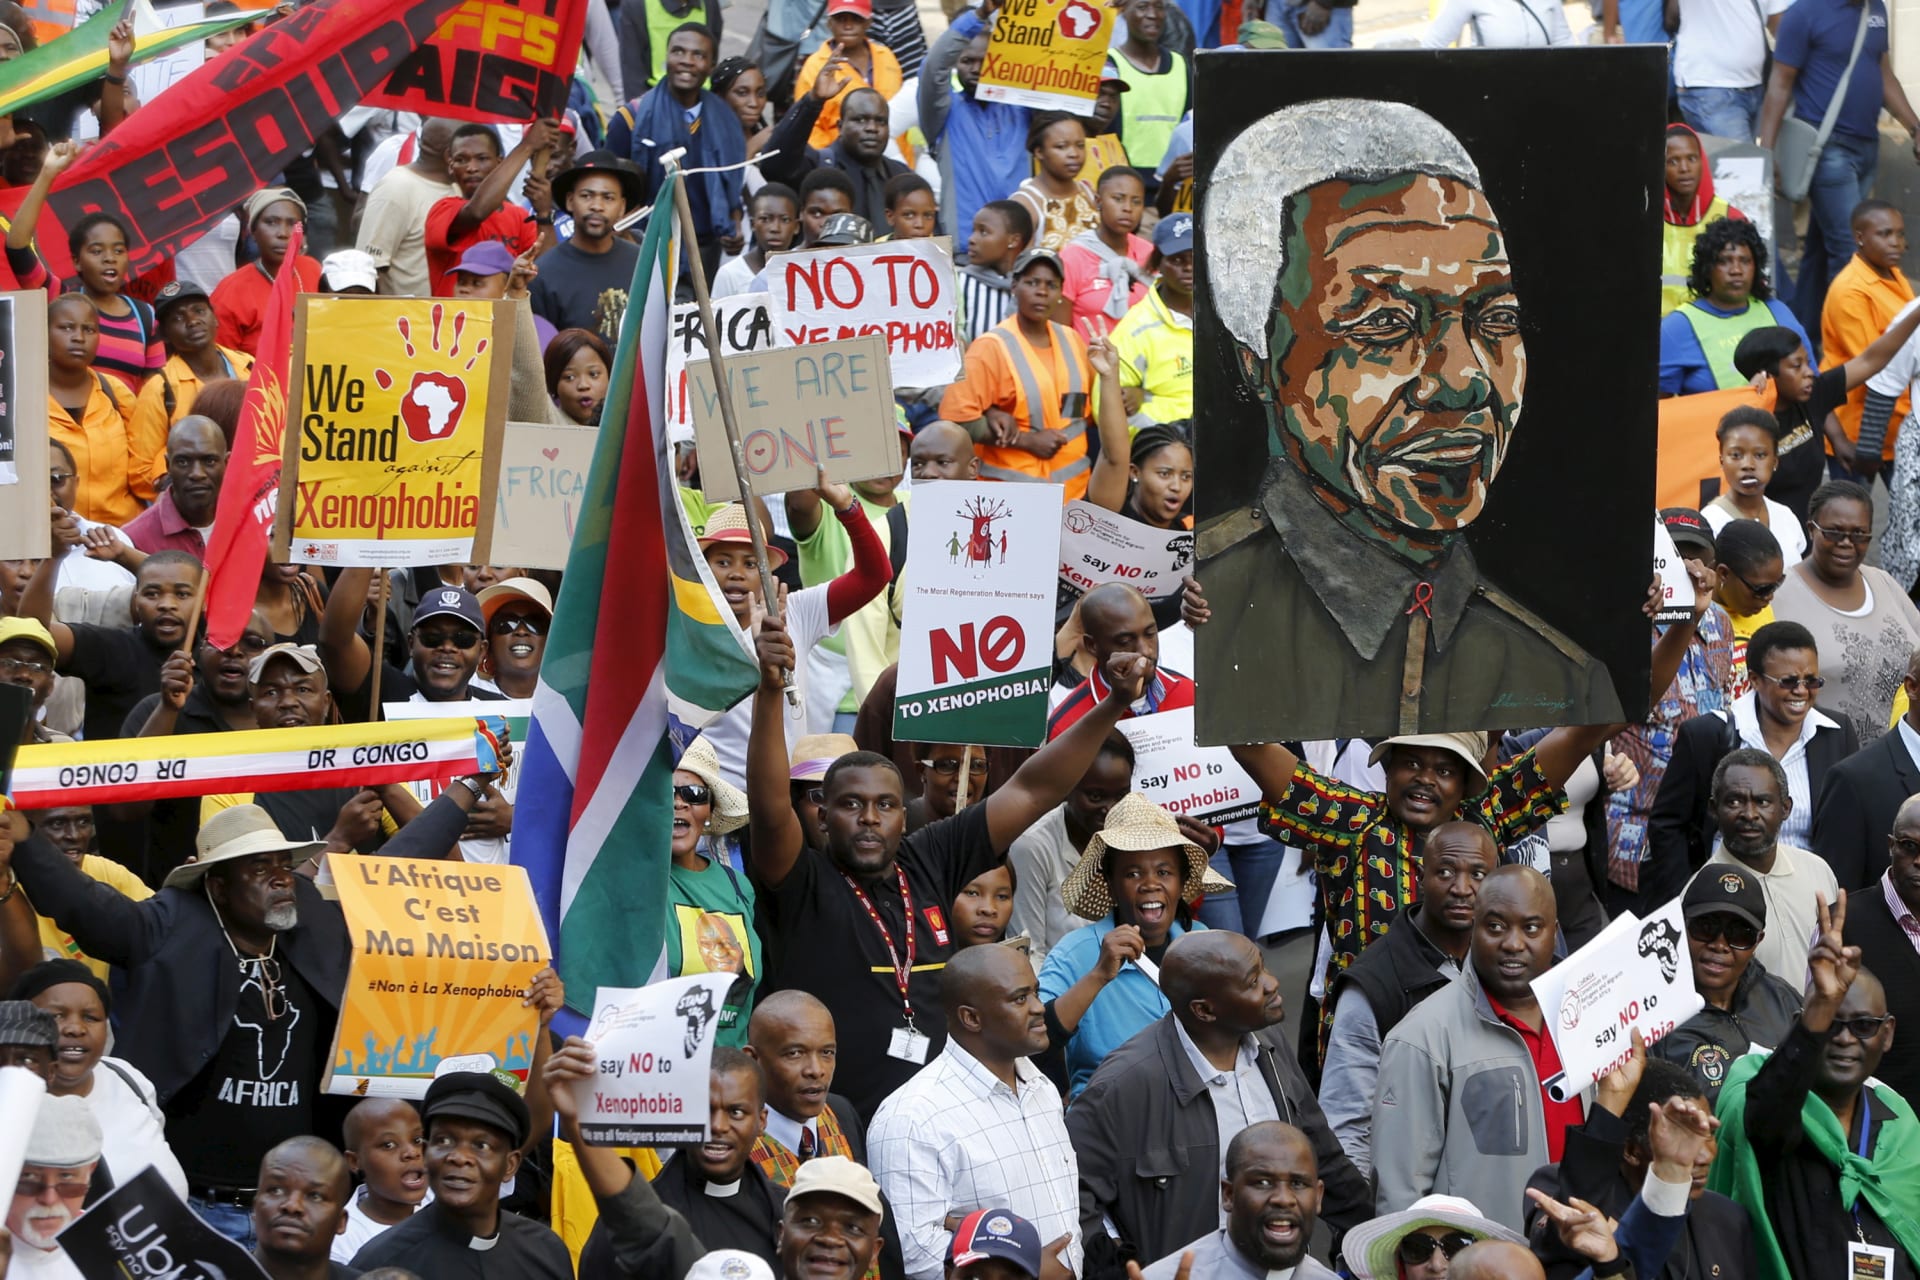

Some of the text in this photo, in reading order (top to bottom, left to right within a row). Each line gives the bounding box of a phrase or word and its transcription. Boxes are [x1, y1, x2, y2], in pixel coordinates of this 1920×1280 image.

[992, 16, 1056, 47] Stand
[980, 52, 1101, 94] Xenophobia
[785, 255, 939, 312] NO TO
[306, 364, 365, 413] We
[696, 367, 769, 418] WE
[796, 352, 868, 400] ARE
[302, 413, 399, 462] Stand
[743, 416, 851, 475] ONE
[384, 450, 484, 496] against
[294, 481, 479, 540] Xenophobia
[1665, 514, 1699, 525] Oxford
[1082, 553, 1158, 579] say NO to
[1655, 556, 1666, 569] to
[916, 586, 1045, 601] The Moral Regeneration Movement says
[929, 614, 1026, 685] NO
[899, 677, 1049, 719] TO XENOPHOBIA!
[308, 742, 428, 769] DR CONGO
[59, 758, 187, 788] DR CONGO
[1140, 762, 1222, 789] say NO to
[359, 862, 502, 897] L'Afrique
[404, 898, 480, 924] C'est
[365, 930, 539, 963] Ma Maison
[1639, 922, 1666, 952] STAND
[368, 980, 525, 1000] #Non à La Xenophobia
[1595, 994, 1657, 1048] say NO to
[600, 1052, 672, 1078] say NO to
[217, 1077, 299, 1107] AFRICA
[595, 1092, 683, 1118] Xenophobia
[593, 1131, 604, 1141] are
[605, 1128, 614, 1141] all
[615, 1128, 654, 1145] foreigners
[655, 1128, 702, 1142] somewhere
[105, 1224, 143, 1275] say no
